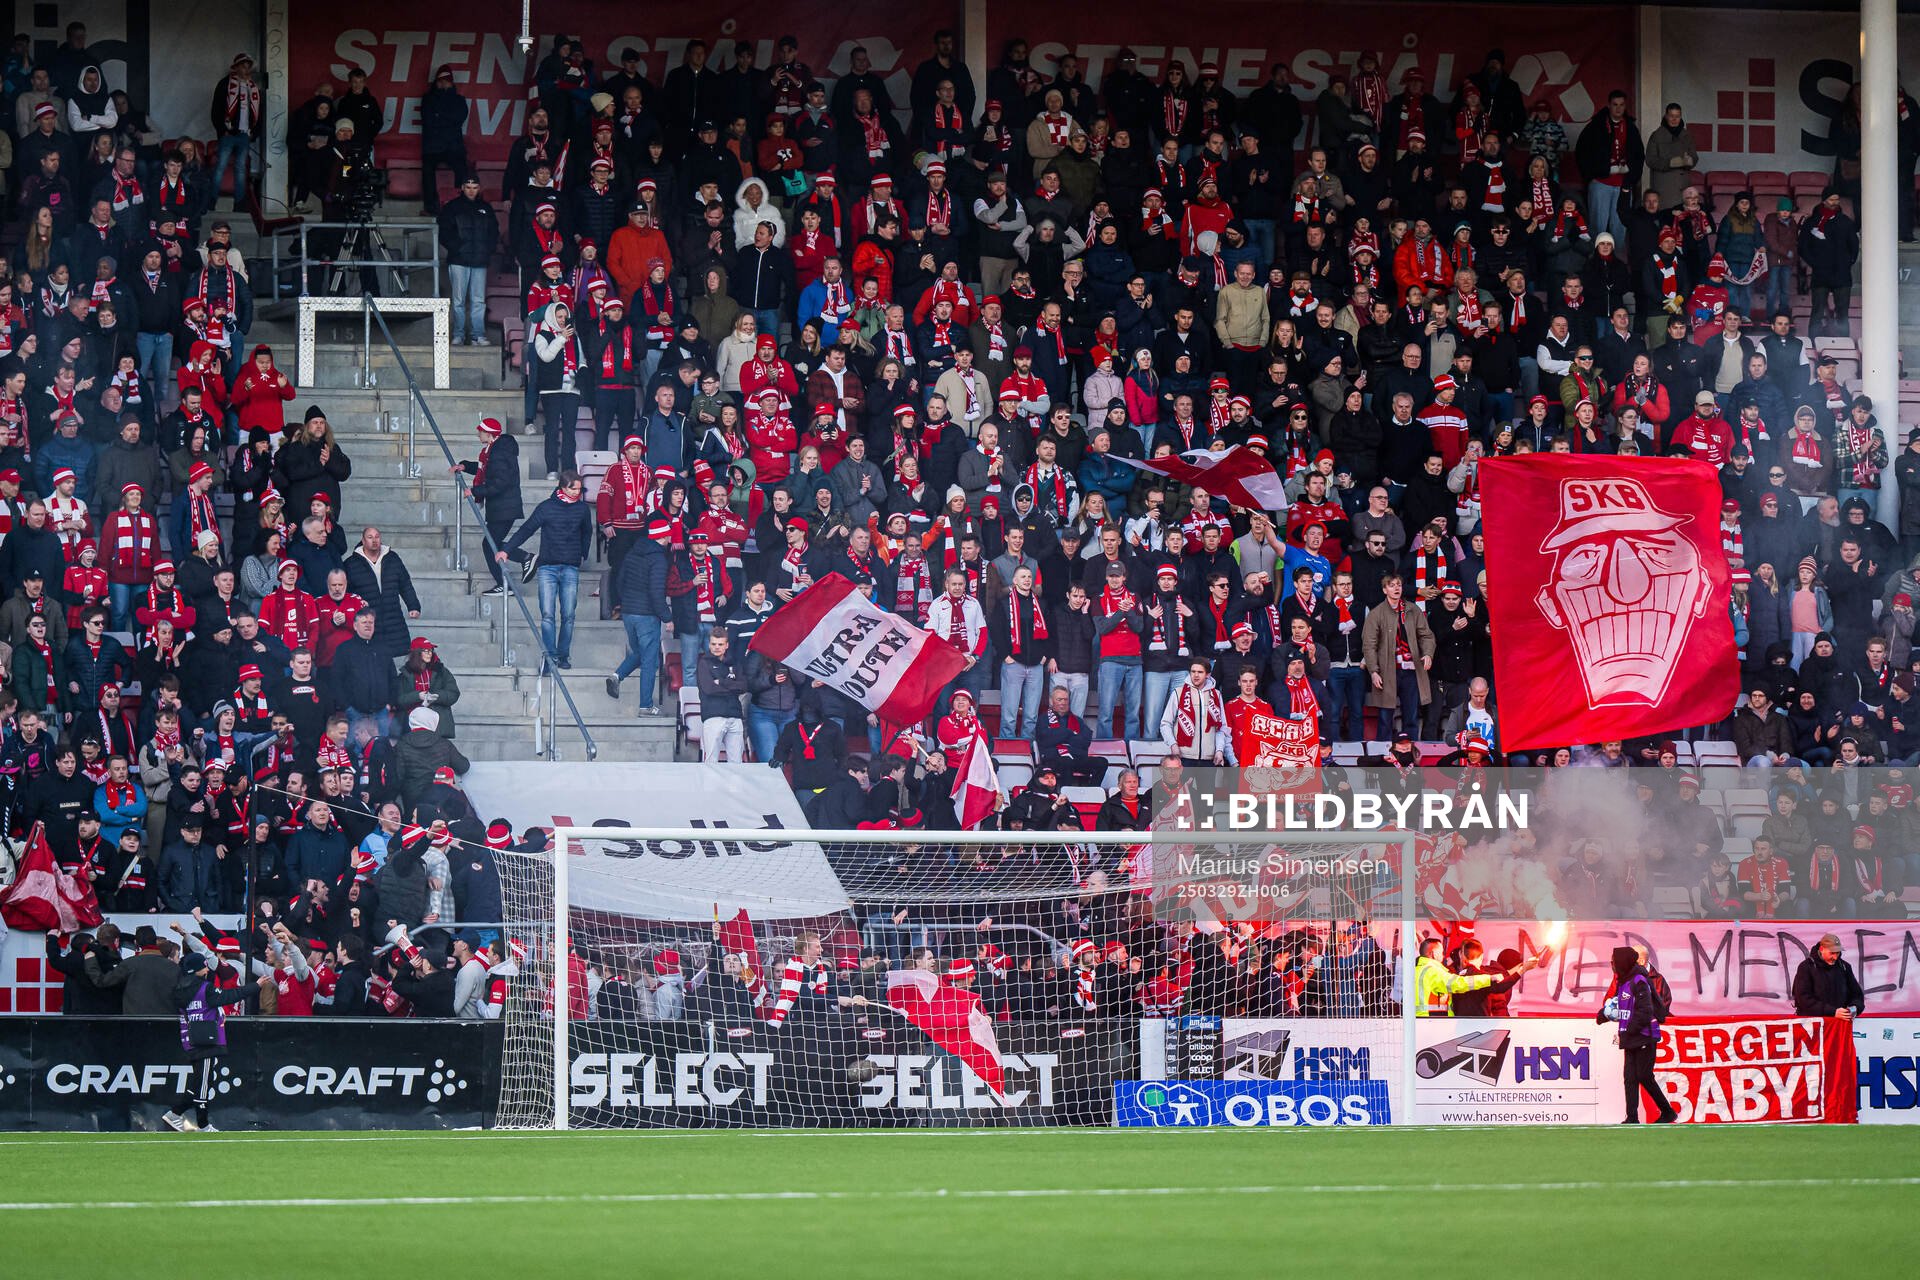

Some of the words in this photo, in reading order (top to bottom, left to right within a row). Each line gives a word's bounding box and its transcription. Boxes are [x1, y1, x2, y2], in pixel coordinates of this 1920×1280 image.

[330, 29, 581, 85] STEN
[374, 416, 399, 431] 13
[1567, 484, 1646, 512] SKB
[1252, 715, 1314, 742] ACAB
[1281, 744, 1304, 757] SKB
[1655, 1021, 1821, 1065] BERGEN
[1190, 1066, 1214, 1074] SELECT
[1294, 1046, 1370, 1080] HSM
[1514, 1046, 1590, 1083] HSM
[46, 1063, 194, 1095] CRAFT
[273, 1065, 425, 1096] CRAFT
[571, 1052, 774, 1107] SELECT
[859, 1054, 1059, 1107] SELECT
[1655, 1065, 1820, 1123] BABY!
[1856, 1056, 1920, 1110] HS
[1224, 1095, 1371, 1126] OBOS
[1458, 1090, 1552, 1103] STÅLENTREPRENØR
[1442, 1110, 1569, 1122] www.hansen-sveis.no
